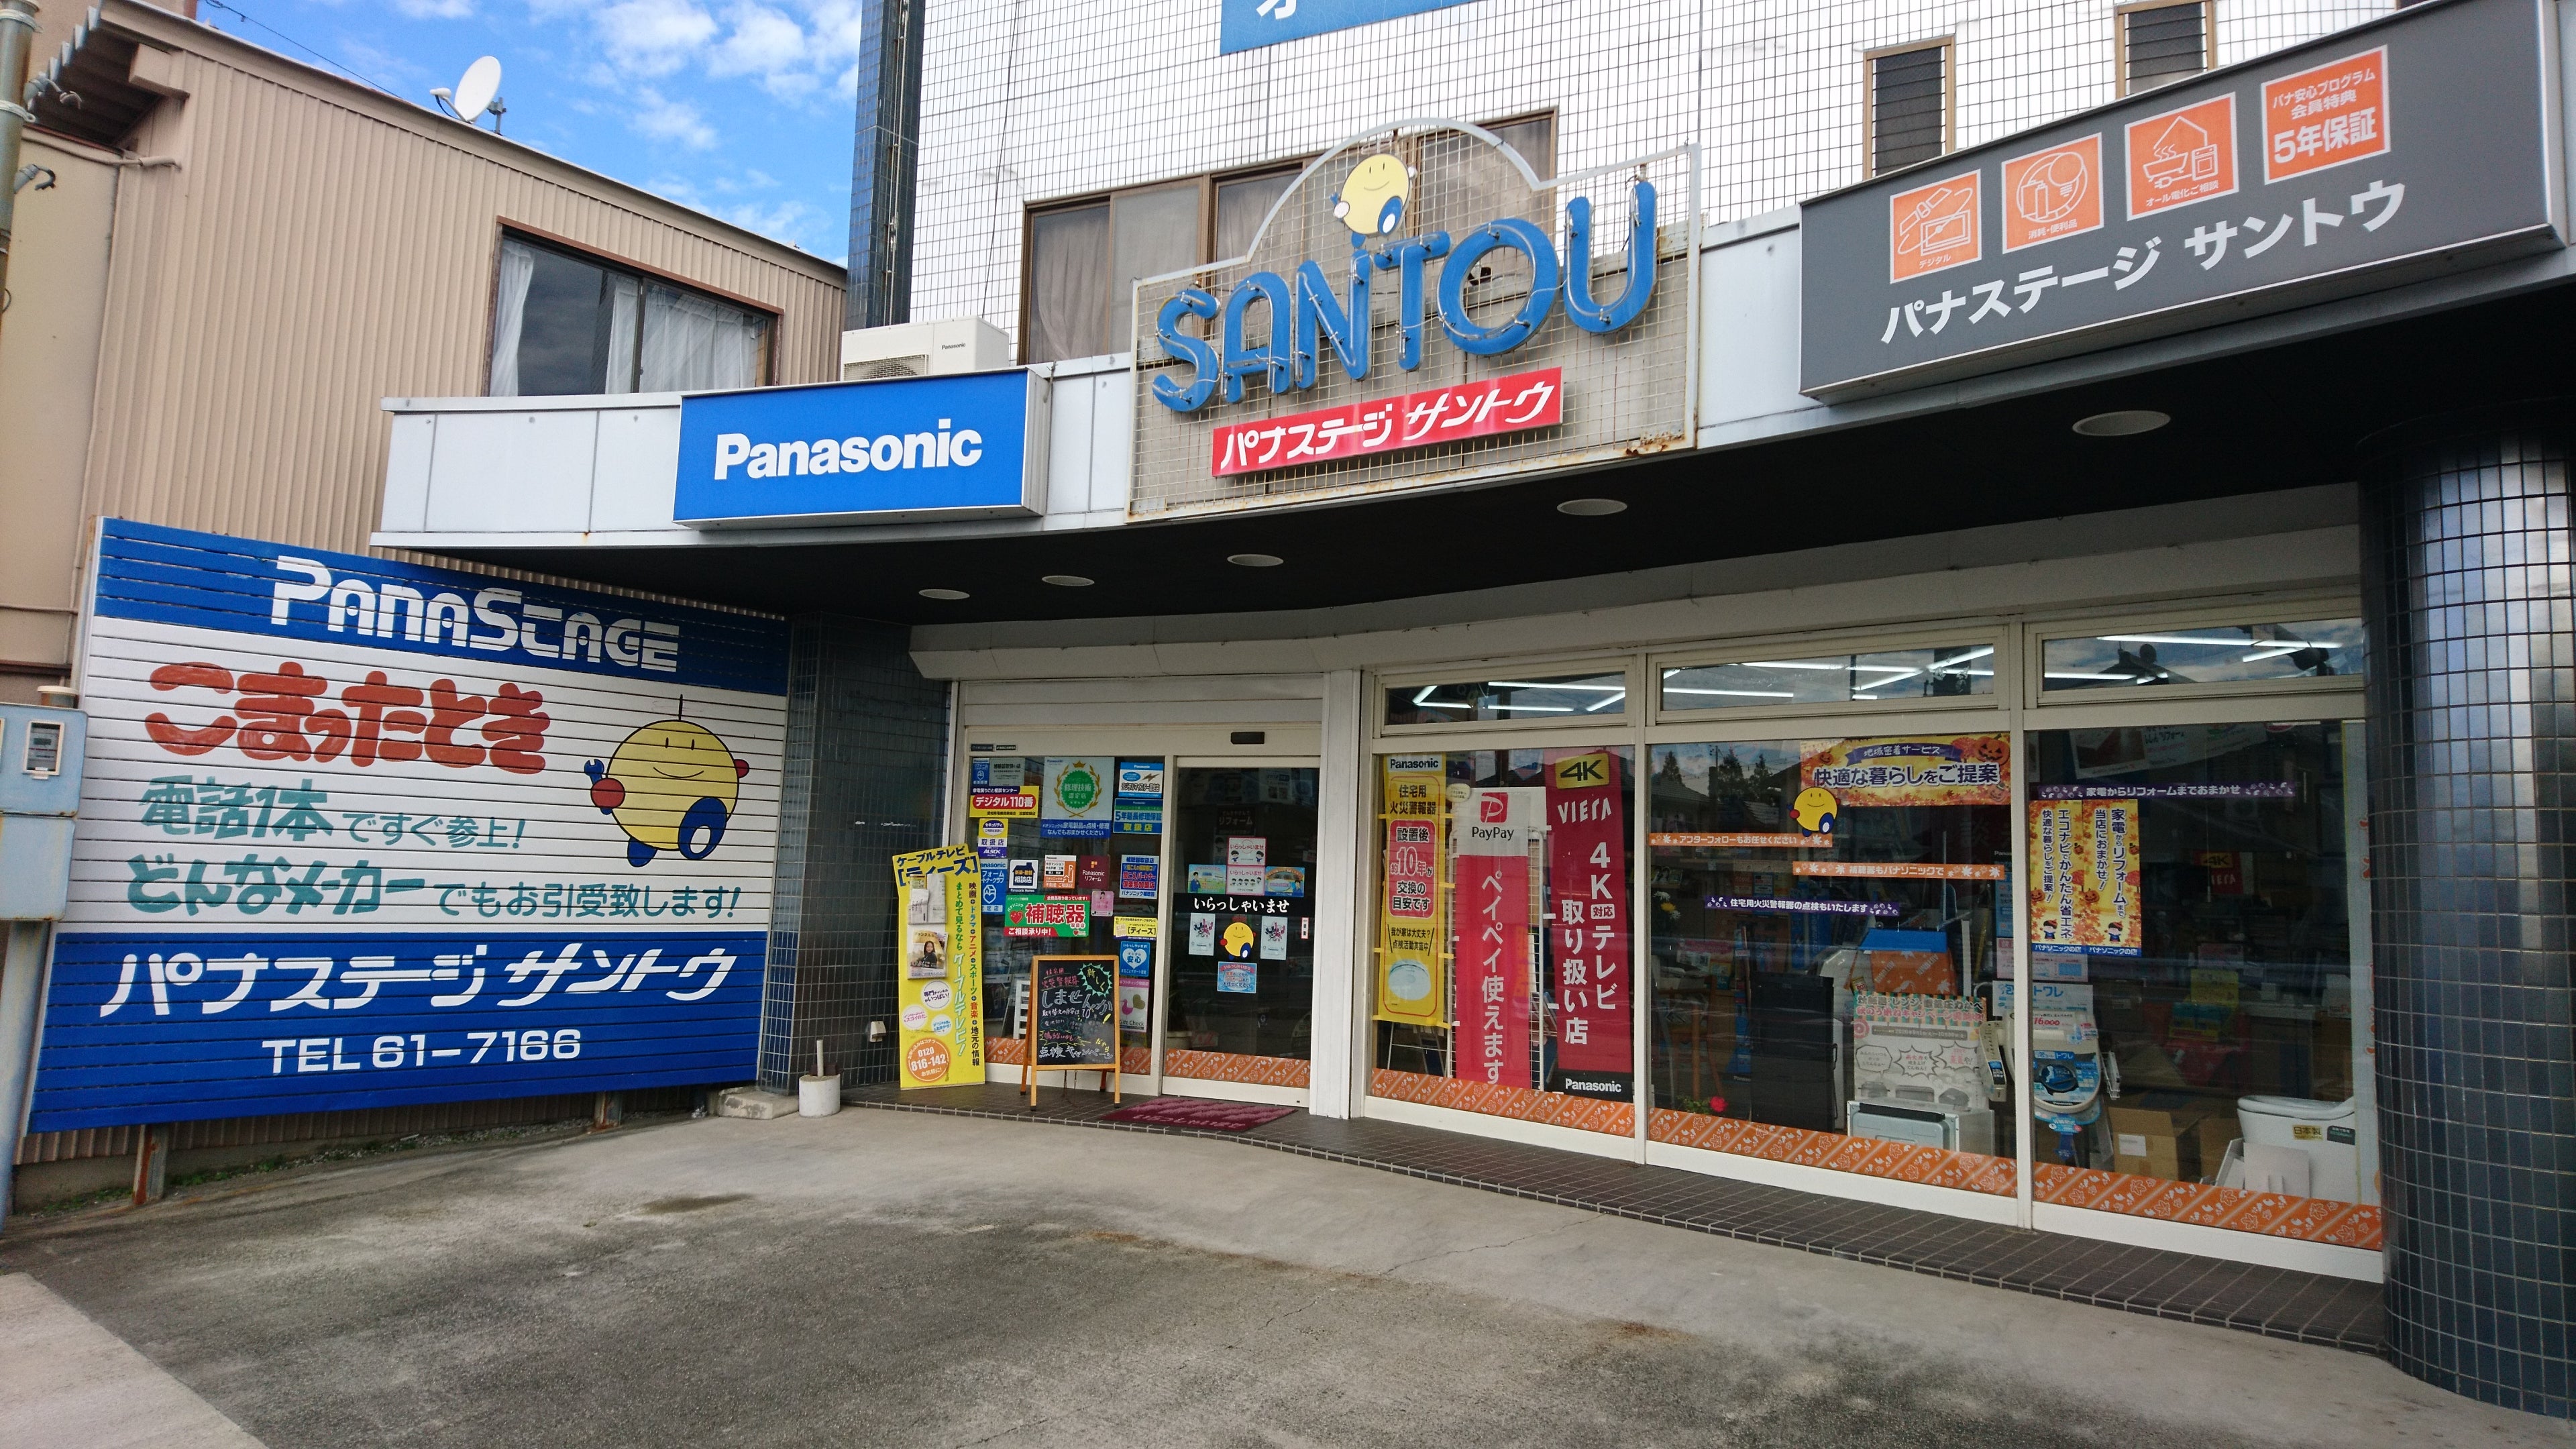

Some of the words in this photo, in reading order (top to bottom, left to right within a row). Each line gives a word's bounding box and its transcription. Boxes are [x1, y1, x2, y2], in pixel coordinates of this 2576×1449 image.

[2272, 66, 2376, 110] パナ安心プログラム
[2290, 89, 2357, 120] 会員特典
[2273, 109, 2377, 164] 5年保証
[2145, 180, 2220, 207] オール電化ご相談
[2027, 219, 2078, 241] 消耗・便利品
[1881, 238, 2160, 345] パナステージ
[2185, 179, 2406, 271] サントウ
[1919, 254, 1951, 270] デジタル
[1152, 181, 1657, 413] SANTOU
[941, 342, 966, 351] Panasonic
[1221, 403, 1393, 470] パナステージ
[1402, 381, 1555, 441] サントウ
[714, 419, 983, 480] Panasonic
[144, 661, 550, 775] こまったとき
[1863, 745, 1941, 757] 地域密着サービス
[1390, 758, 1439, 769] Panasonic
[1560, 760, 1605, 782] 4K
[1813, 763, 2000, 788] 快適な暮らしをご提案
[1399, 785, 1427, 798] 住宅用
[2086, 784, 2241, 796] 家電からリフォームまでおまかせ
[975, 796, 1034, 807] デジタル110番
[1390, 802, 1436, 815] 火災警報器
[1557, 796, 1612, 824] VIERA
[1218, 816, 1253, 826] リフォーム
[1047, 828, 1104, 837] なんでもおまかせください
[1397, 827, 1429, 843] 設置後
[1472, 826, 1515, 841] PayPay
[1678, 835, 1798, 845] アフターフォローもお任せください
[897, 846, 965, 867] ケーブルテレビ
[2042, 810, 2055, 903] 快適な暮らしをご提案!
[2095, 809, 2109, 891] 当店におまかせ!
[1391, 846, 1433, 877] 約10年が
[1849, 865, 1945, 877] 補聴器もパナソニックで
[2112, 808, 2127, 918] 家電からリフォームまで
[2058, 810, 2073, 939] エコナビでかんたん省エネ
[969, 882, 977, 898] 映画
[1397, 881, 1426, 895] 交換の
[1194, 896, 1290, 914] いらっしゃいませ
[1393, 896, 1430, 910] 目安です
[1730, 898, 1868, 912] 住宅用火災警報器の点検もいたします
[955, 881, 964, 951] まとめて見るなら
[1025, 903, 1085, 925] 補聴器
[1008, 928, 1052, 936] ご相談承り中!
[1391, 927, 1431, 938] 我が家は大丈夫?
[969, 935, 977, 957] アニメ
[2035, 945, 2081, 953] パナソニックの店
[2089, 947, 2138, 955] パナソニックの店
[101, 944, 487, 1017] パナステージ
[498, 943, 737, 1006] サントウ
[969, 964, 977, 996] スポーツ
[1087, 967, 1106, 991] 新しく
[1481, 871, 1505, 1085] ペイペイ使えます
[1561, 898, 1589, 1044] 取り扱い店
[2033, 985, 2063, 998] トワレ
[953, 953, 966, 1057] ケーブルテレビ!
[970, 1002, 978, 1018] 音楽
[262, 1037, 362, 1073] TEL
[372, 1030, 581, 1069] 61-7166
[918, 1046, 934, 1057] 0120
[971, 1026, 981, 1067] 地元の情報
[910, 1054, 947, 1071] 816-142
[1565, 1077, 1622, 1093] Panasonic
[2294, 1126, 2321, 1135] 日本製
